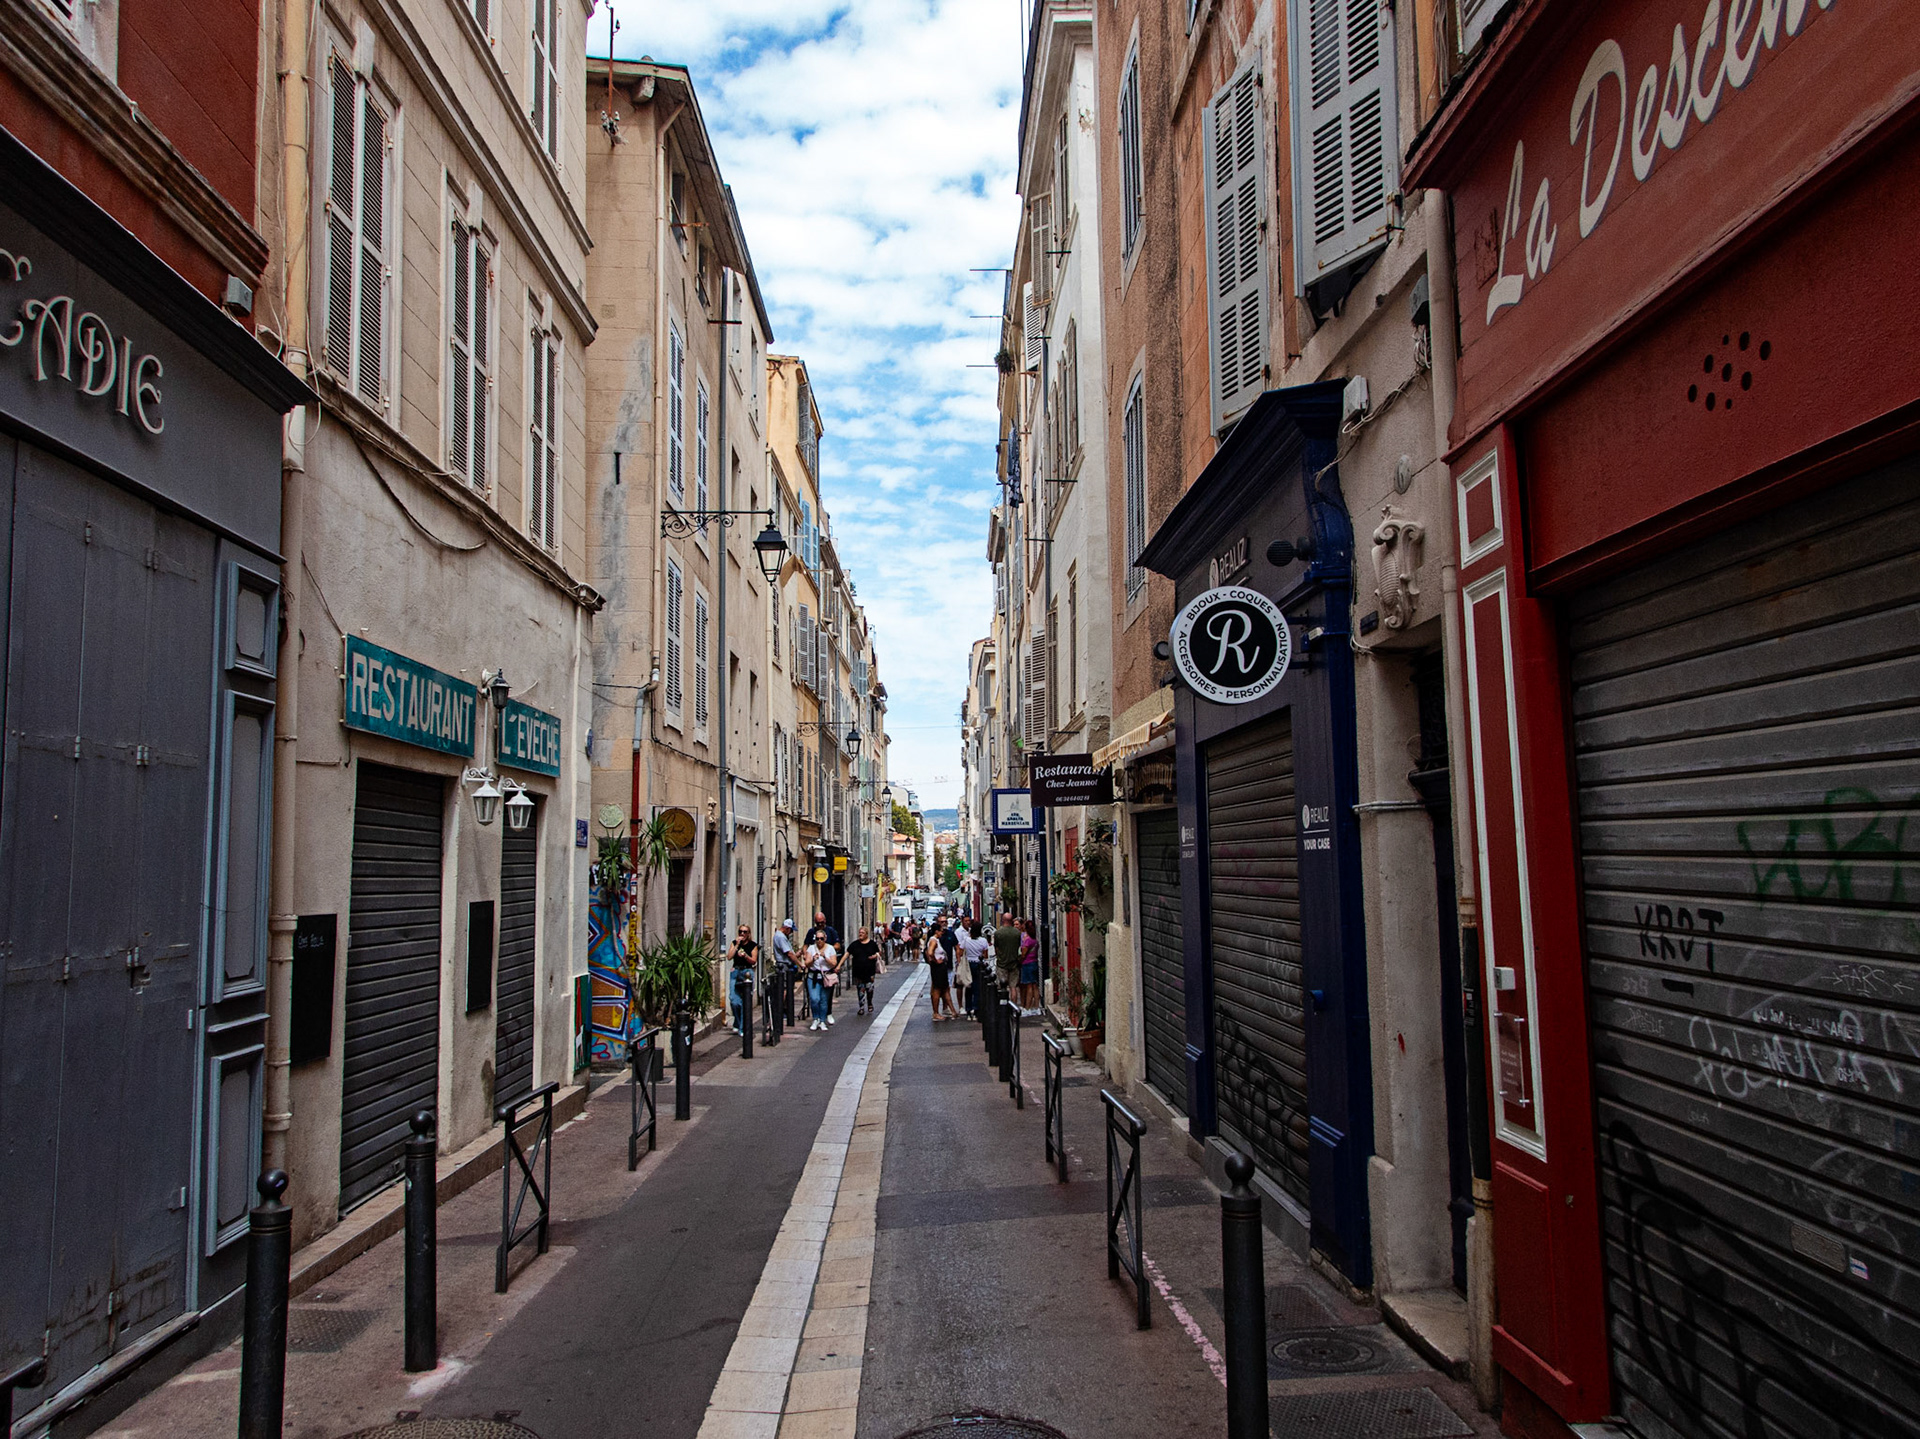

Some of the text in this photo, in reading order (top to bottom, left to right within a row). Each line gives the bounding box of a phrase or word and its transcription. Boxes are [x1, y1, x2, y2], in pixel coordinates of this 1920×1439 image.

[1486, 138, 1557, 326] La
[1219, 536, 1248, 583] REALIZ
[1186, 590, 1273, 621] BIJOUX COQUES
[1178, 622, 1288, 699] ACCESSOIRES PERSONNALISATION
[1206, 609, 1260, 675] R
[351, 651, 474, 746] RESTAURANT
[1034, 764, 1107, 780] Restaurat
[1045, 778, 1098, 789] Chez Jeannot
[1310, 806, 1330, 823] REALIZ
[1303, 837, 1331, 850] YOUR CASE
